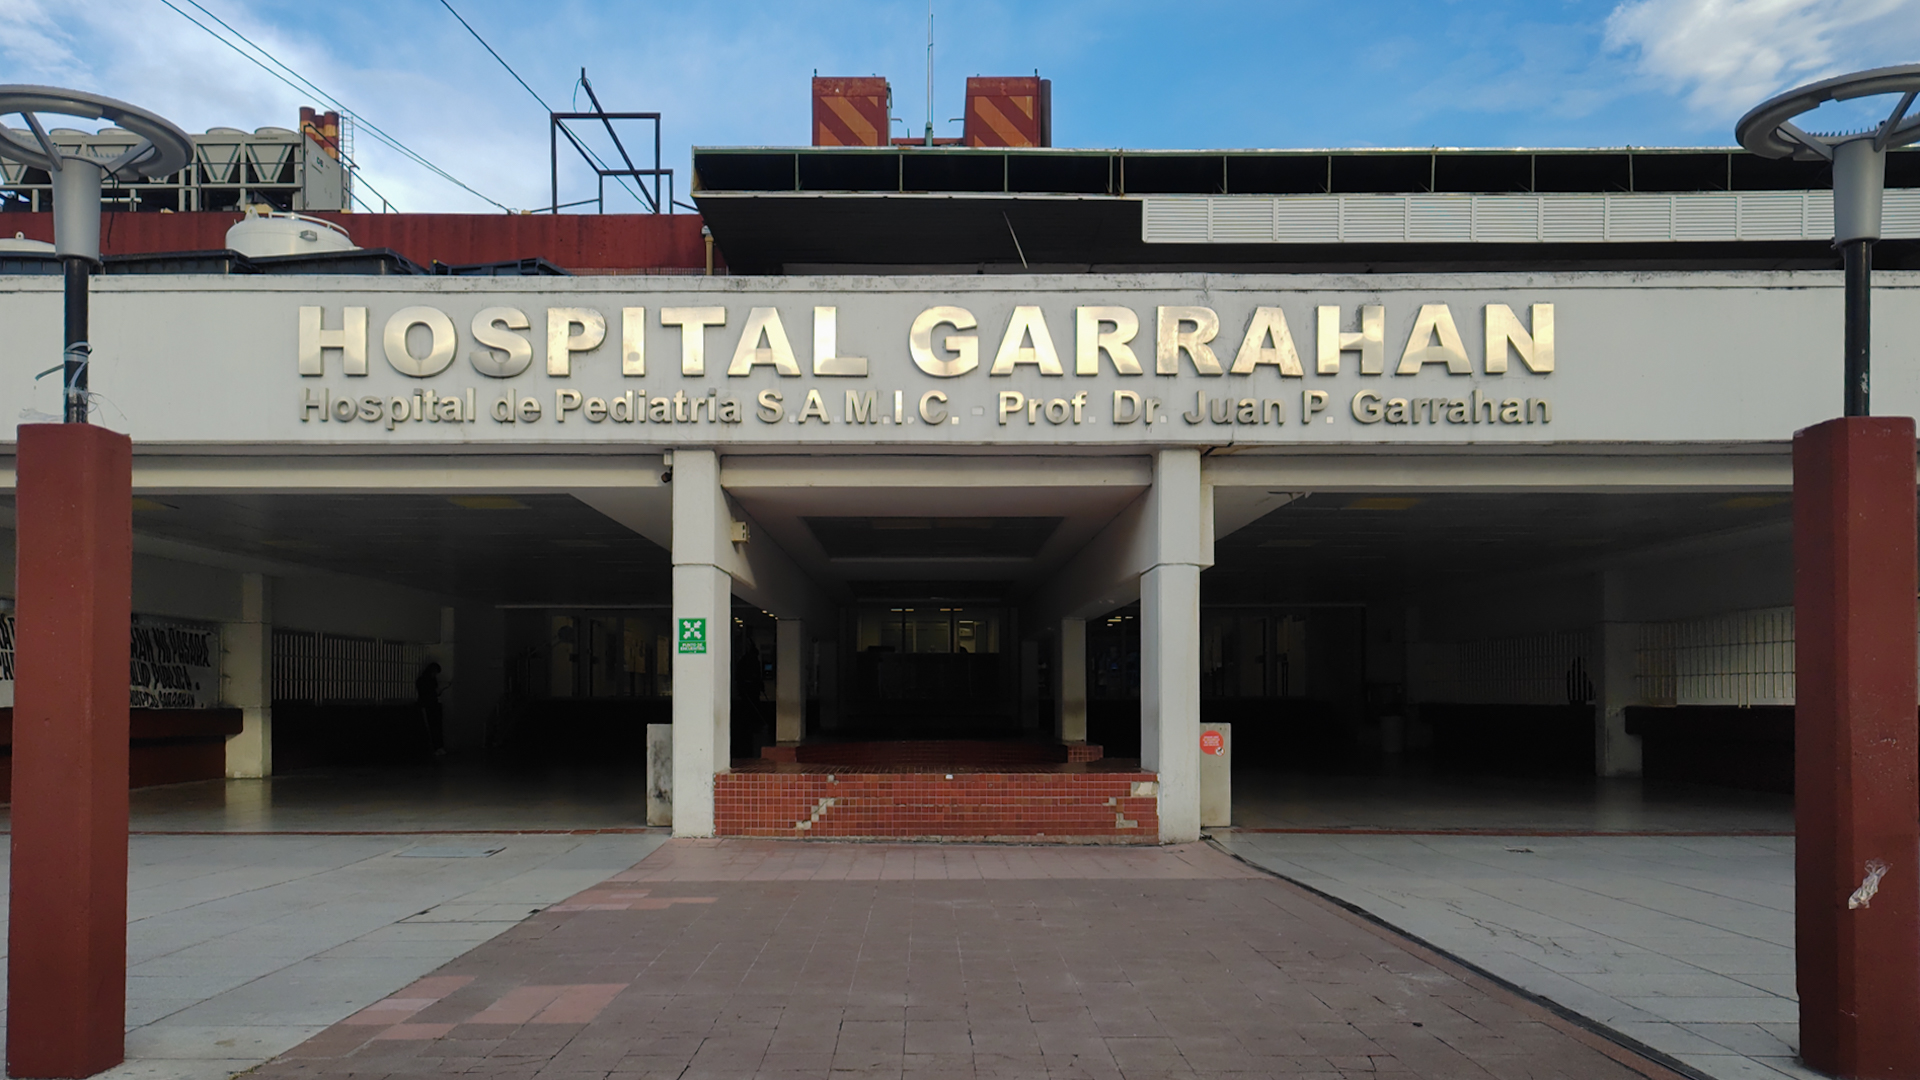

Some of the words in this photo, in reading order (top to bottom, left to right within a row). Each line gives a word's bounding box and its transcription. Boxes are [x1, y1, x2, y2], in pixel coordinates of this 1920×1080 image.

[299, 305, 868, 377] HOSPITAL
[908, 303, 1555, 378] GARRAHAN
[301, 388, 475, 430] Hospital
[491, 388, 542, 423] de
[999, 389, 1096, 424] Prof.
[1113, 389, 1167, 425] Dr.
[1183, 389, 1286, 425] Juan
[1303, 389, 1334, 424] P.
[1351, 388, 1552, 424] Garrahan
